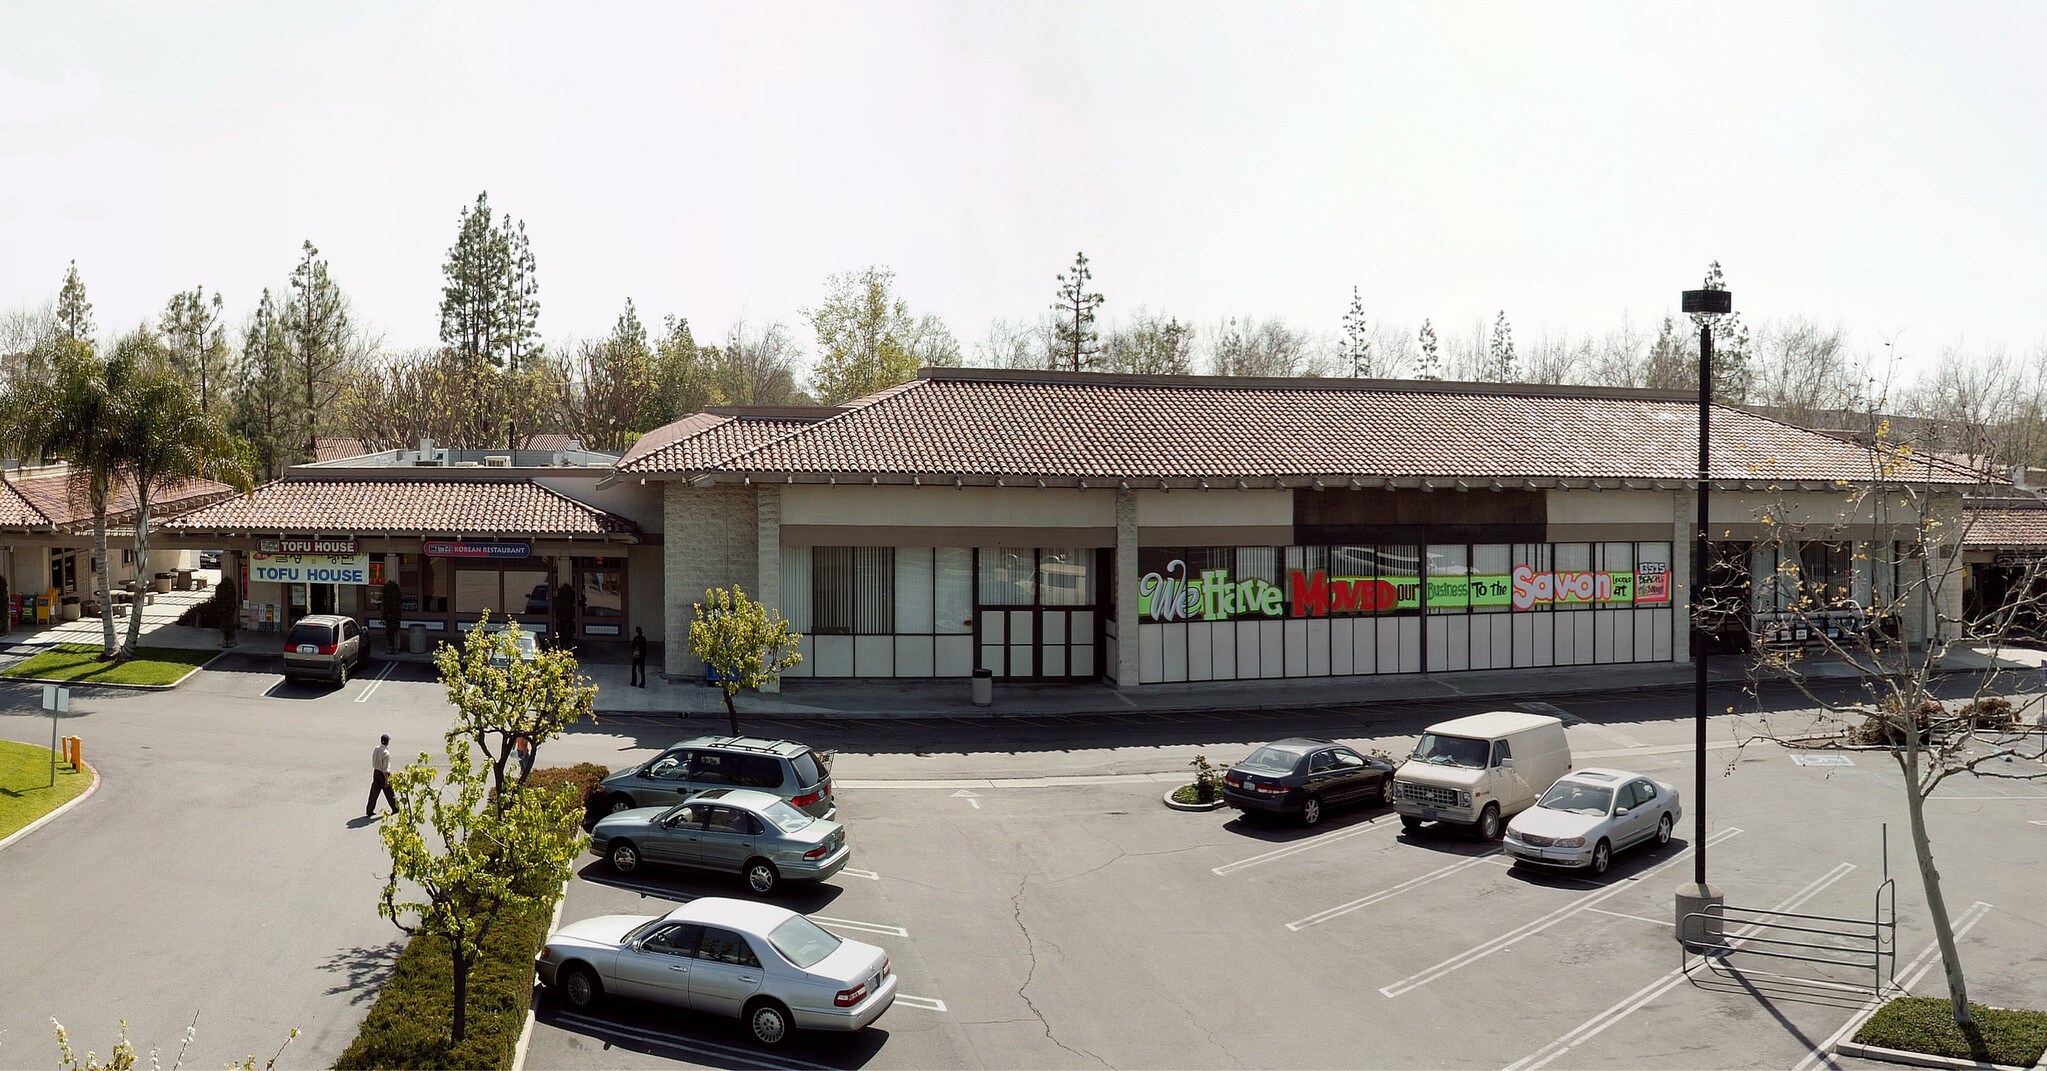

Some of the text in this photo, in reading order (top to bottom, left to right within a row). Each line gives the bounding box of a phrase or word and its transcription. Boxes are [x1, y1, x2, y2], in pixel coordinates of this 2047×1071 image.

[281, 541, 311, 552] TOFU
[314, 541, 355, 552] HOUSE
[483, 546, 526, 554] RESTAURANT
[257, 567, 299, 580] TOFU
[307, 569, 362, 582] HOUSE
[1140, 559, 1200, 621] We
[1201, 569, 1283, 620] Have
[1290, 570, 1396, 617] MOVED
[1427, 582, 1468, 601] Business
[1471, 581, 1488, 598] To
[1489, 580, 1508, 596] the
[1613, 585, 1627, 597] at
